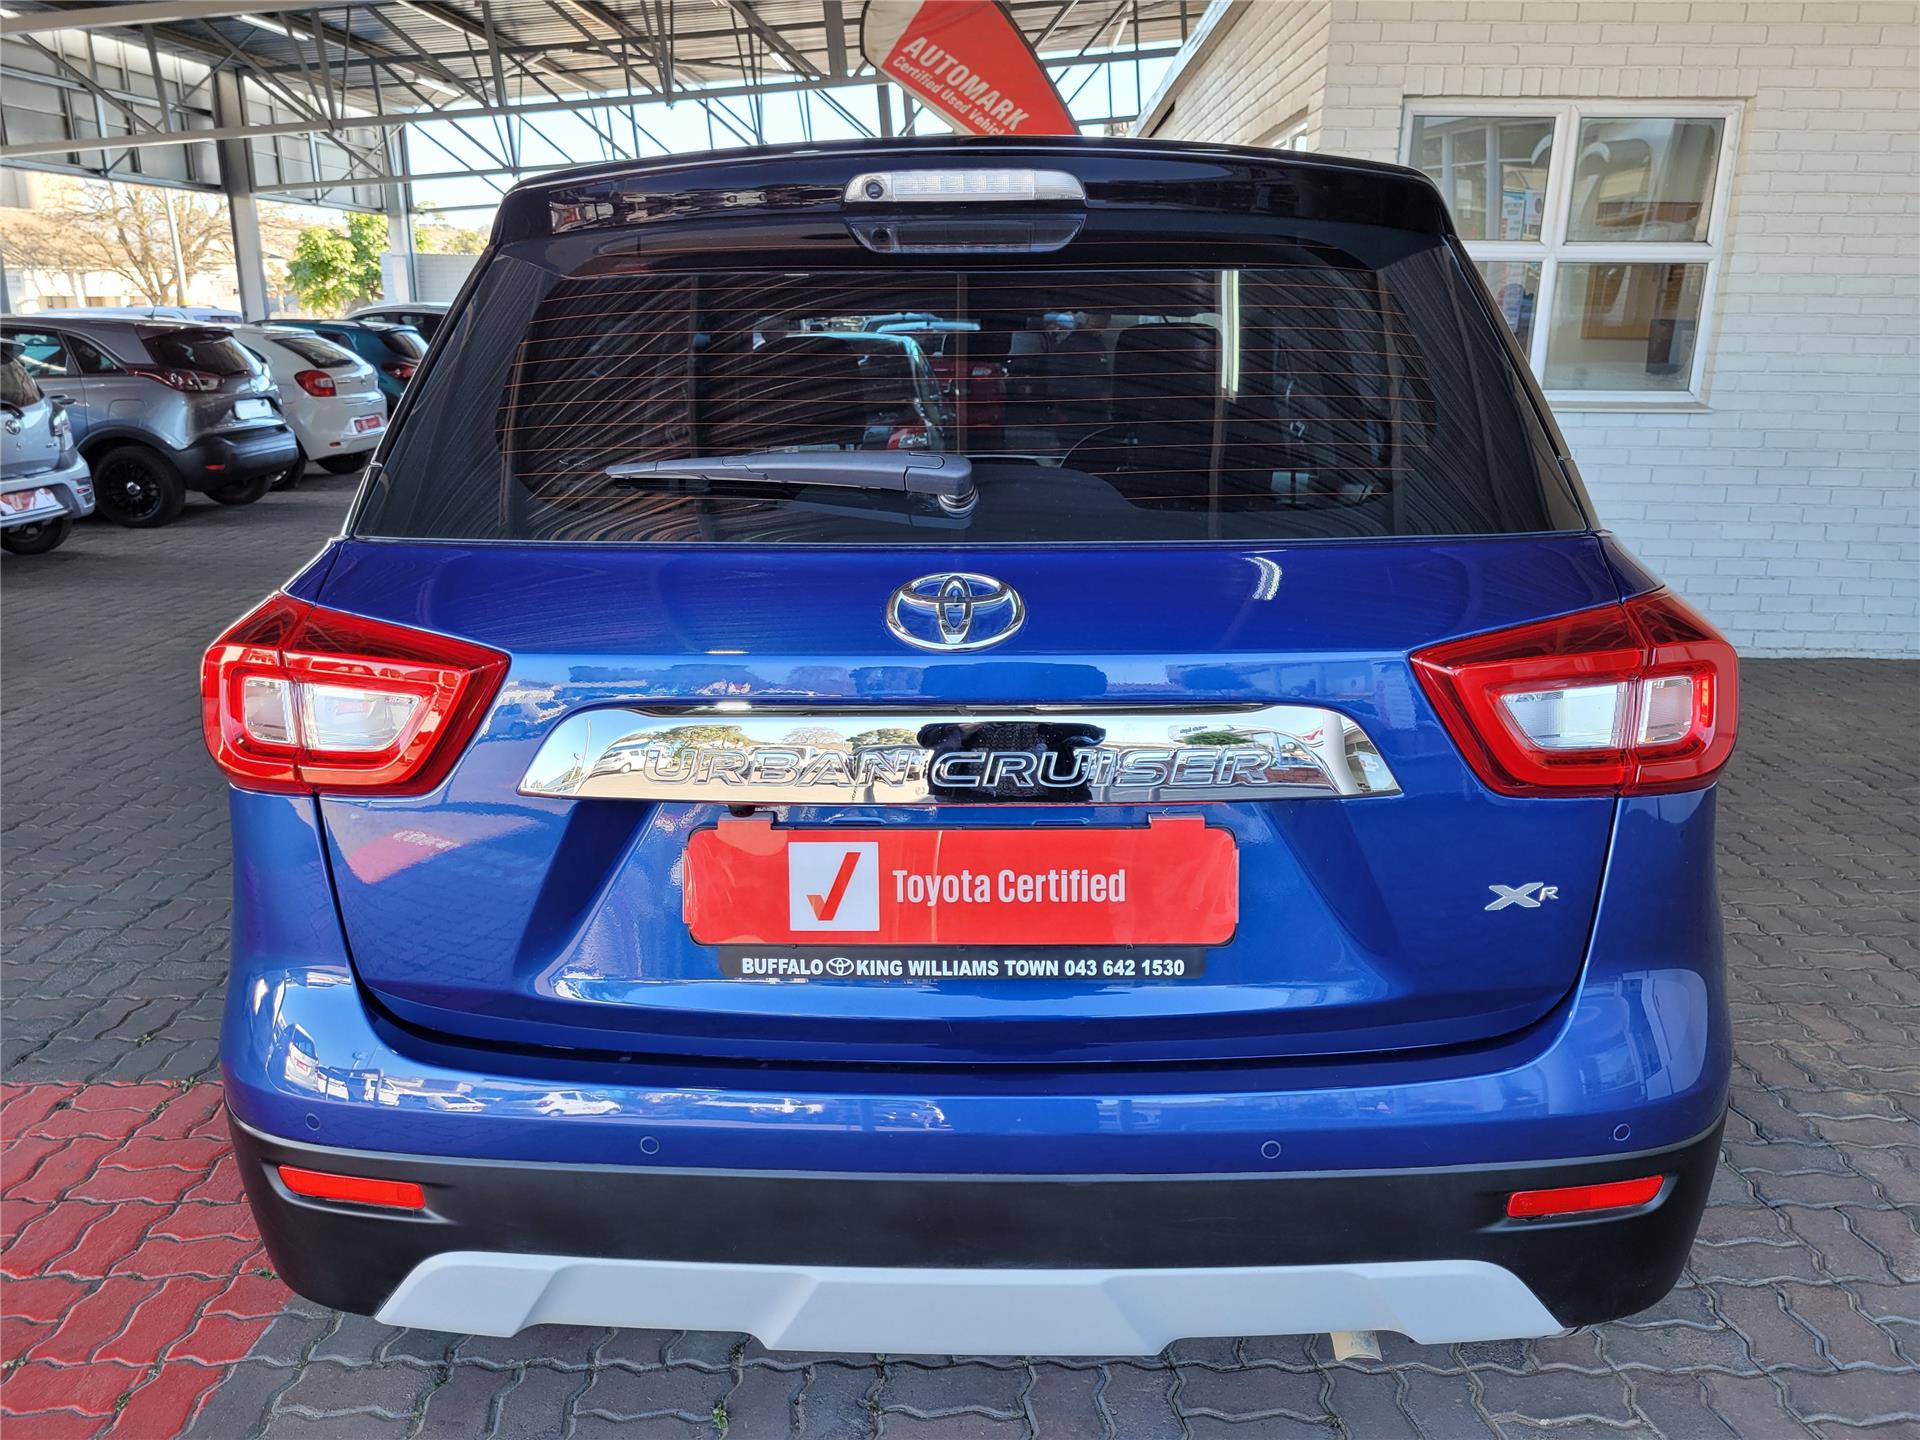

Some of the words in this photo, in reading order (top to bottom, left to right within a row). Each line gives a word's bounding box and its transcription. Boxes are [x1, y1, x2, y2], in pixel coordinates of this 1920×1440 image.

[892, 56, 945, 93] Certified
[940, 89, 972, 114] Used
[902, 36, 1030, 131] AUTOMARK
[642, 748, 914, 788] URBAN
[930, 749, 1274, 788] CRUISER
[892, 869, 991, 907] Toyota
[998, 868, 1126, 903] Certified
[741, 957, 824, 975] BUFFALO
[856, 960, 903, 976] KING
[907, 959, 999, 976] WILLIAMS
[1004, 960, 1059, 976] TOWN
[1064, 959, 1097, 976] 043
[1102, 959, 1136, 976] 642
[1141, 959, 1185, 976] 1530
